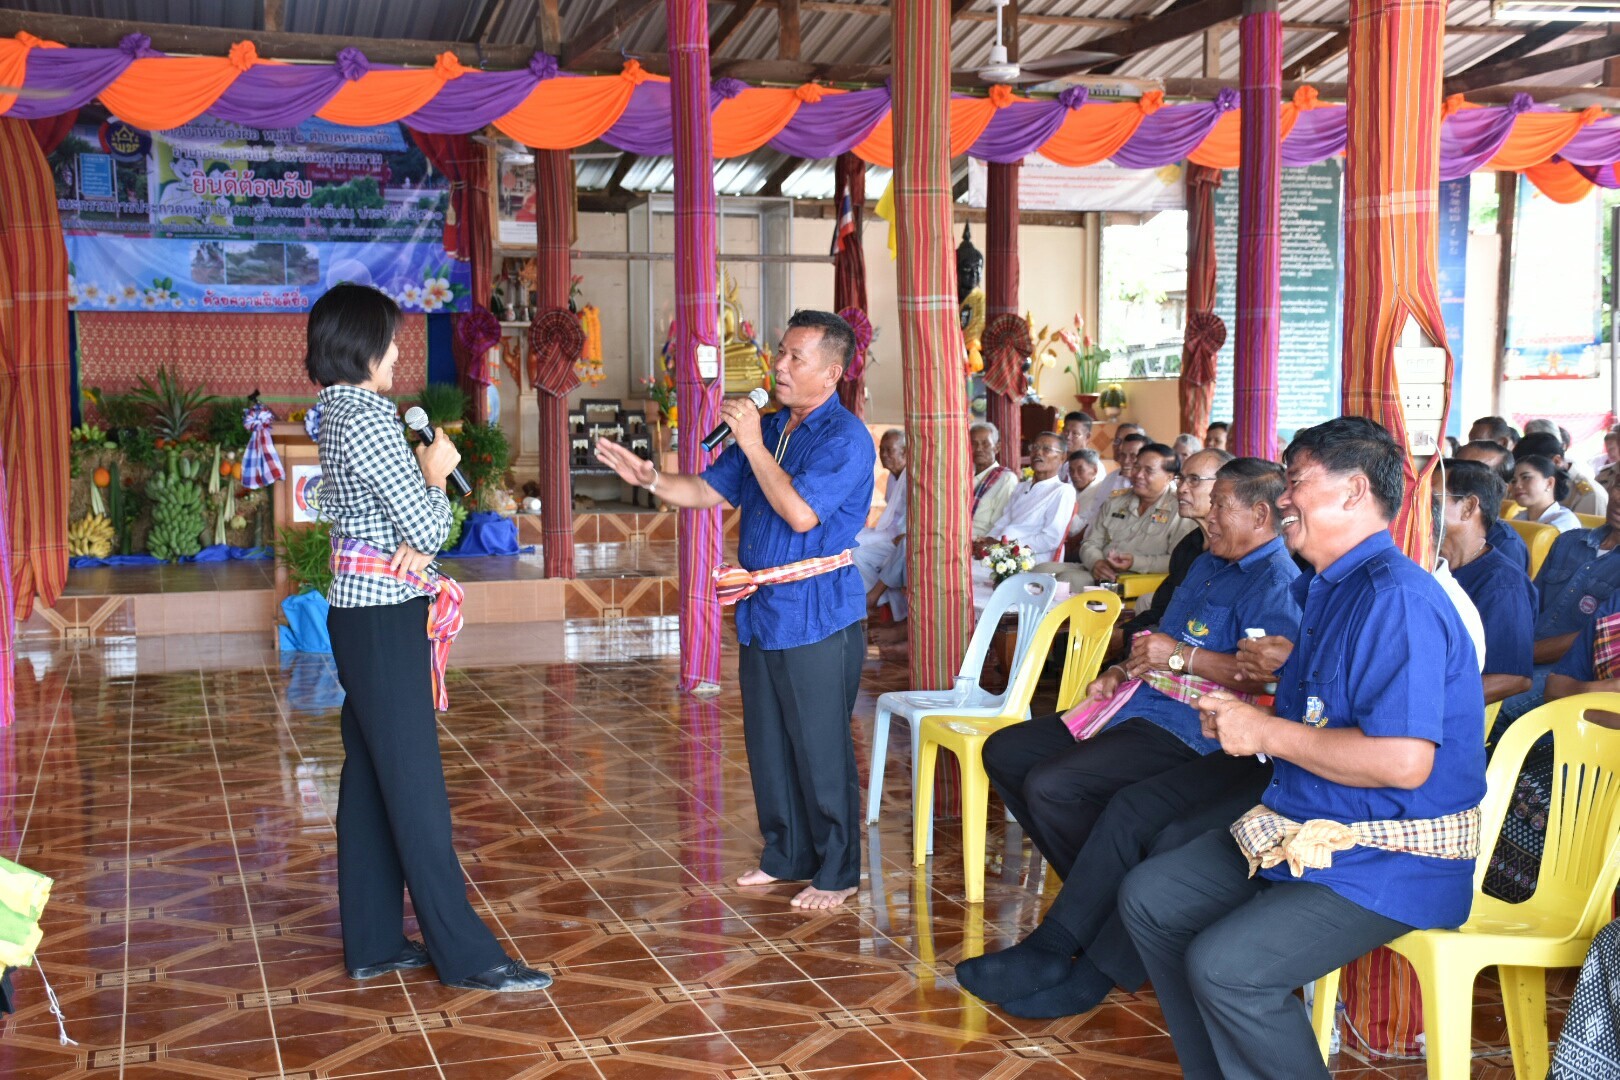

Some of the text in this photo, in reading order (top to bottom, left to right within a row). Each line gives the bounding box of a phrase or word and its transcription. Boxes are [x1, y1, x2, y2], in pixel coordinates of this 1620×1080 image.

[263, 127, 292, 146] หมูที
[191, 170, 313, 199] ยินดีต้อนรับ
[203, 286, 309, 307] ด้วยความยินดียิ่ง
